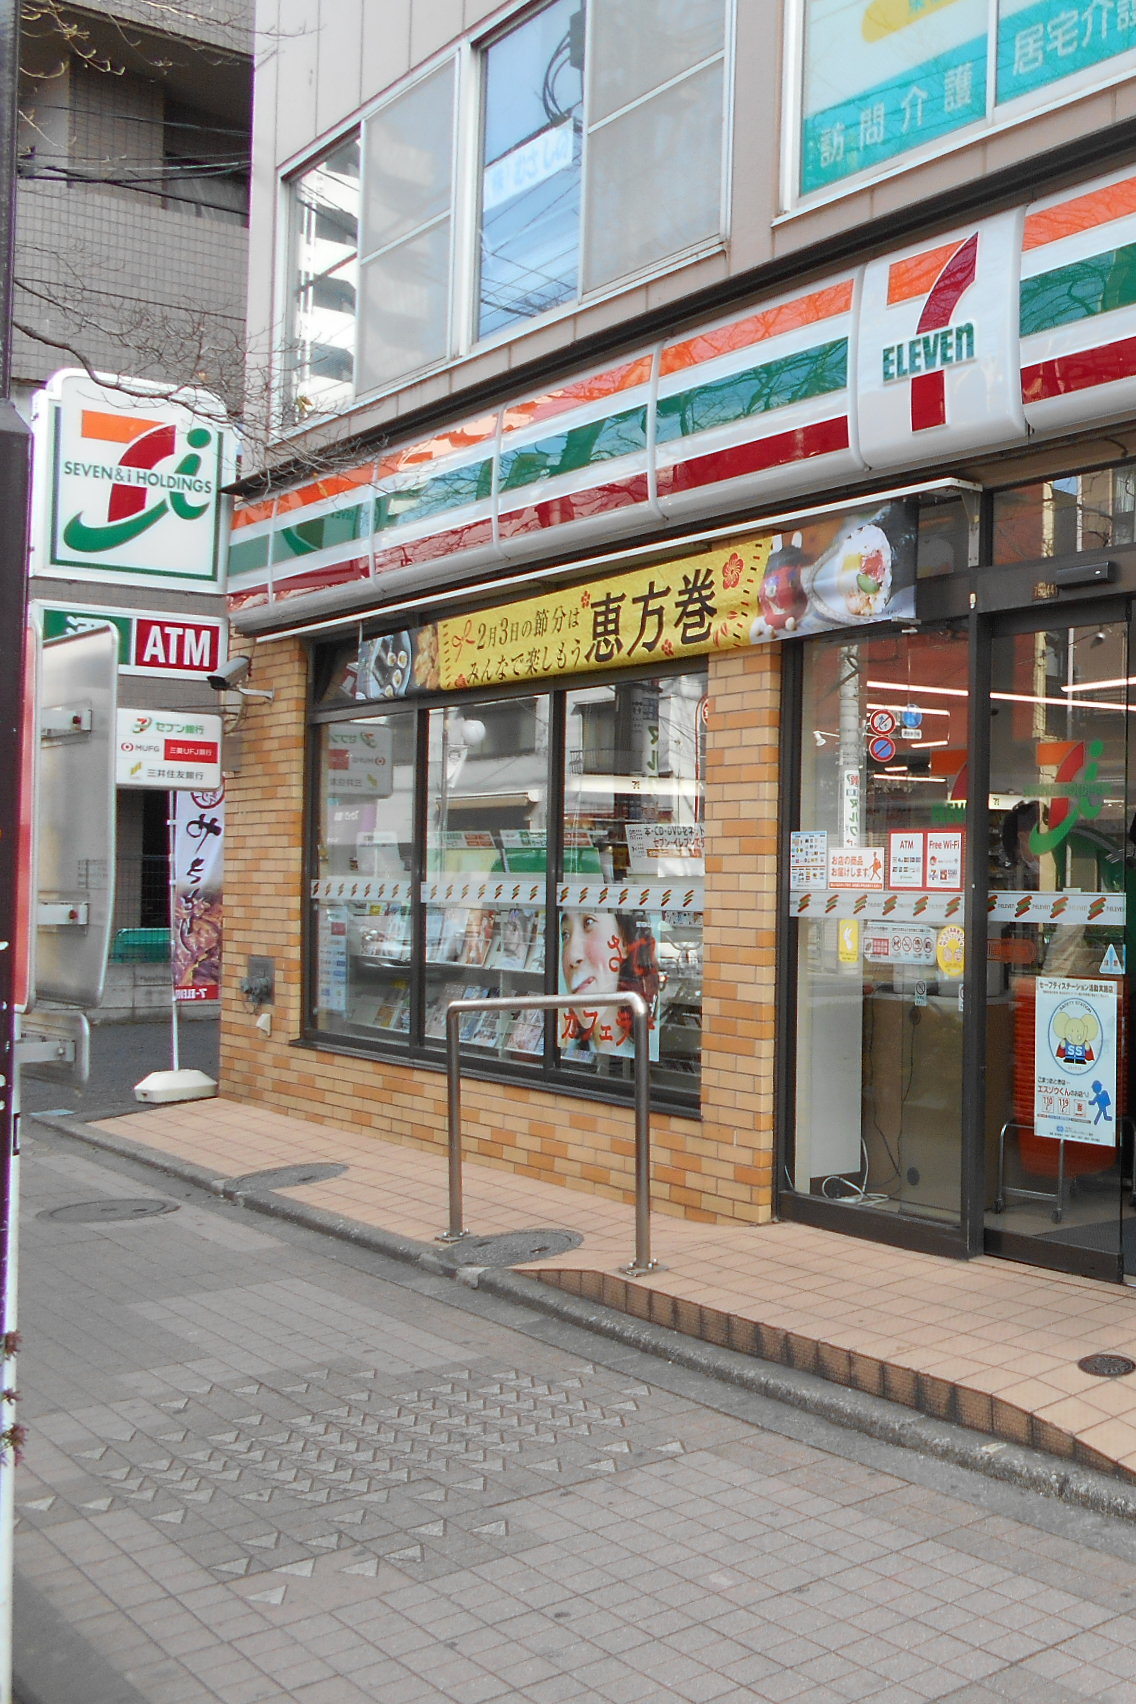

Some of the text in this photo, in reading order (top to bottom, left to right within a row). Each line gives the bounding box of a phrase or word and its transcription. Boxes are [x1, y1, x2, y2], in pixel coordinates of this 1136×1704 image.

[819, 61, 973, 169] 訪問介護
[137, 470, 212, 494] HOLDINGS
[476, 605, 581, 650] 2月3日の節分は
[583, 567, 718, 664] 恵方巻
[144, 626, 210, 667] ATM
[465, 637, 581, 684] みんなで楽しもう
[147, 768, 204, 780] 三井住友銀行
[900, 840, 914, 849] ATM
[929, 840, 960, 850] Free Wi-Fi
[831, 855, 864, 866] お店の商品
[1067, 1045, 1083, 1056] SS
